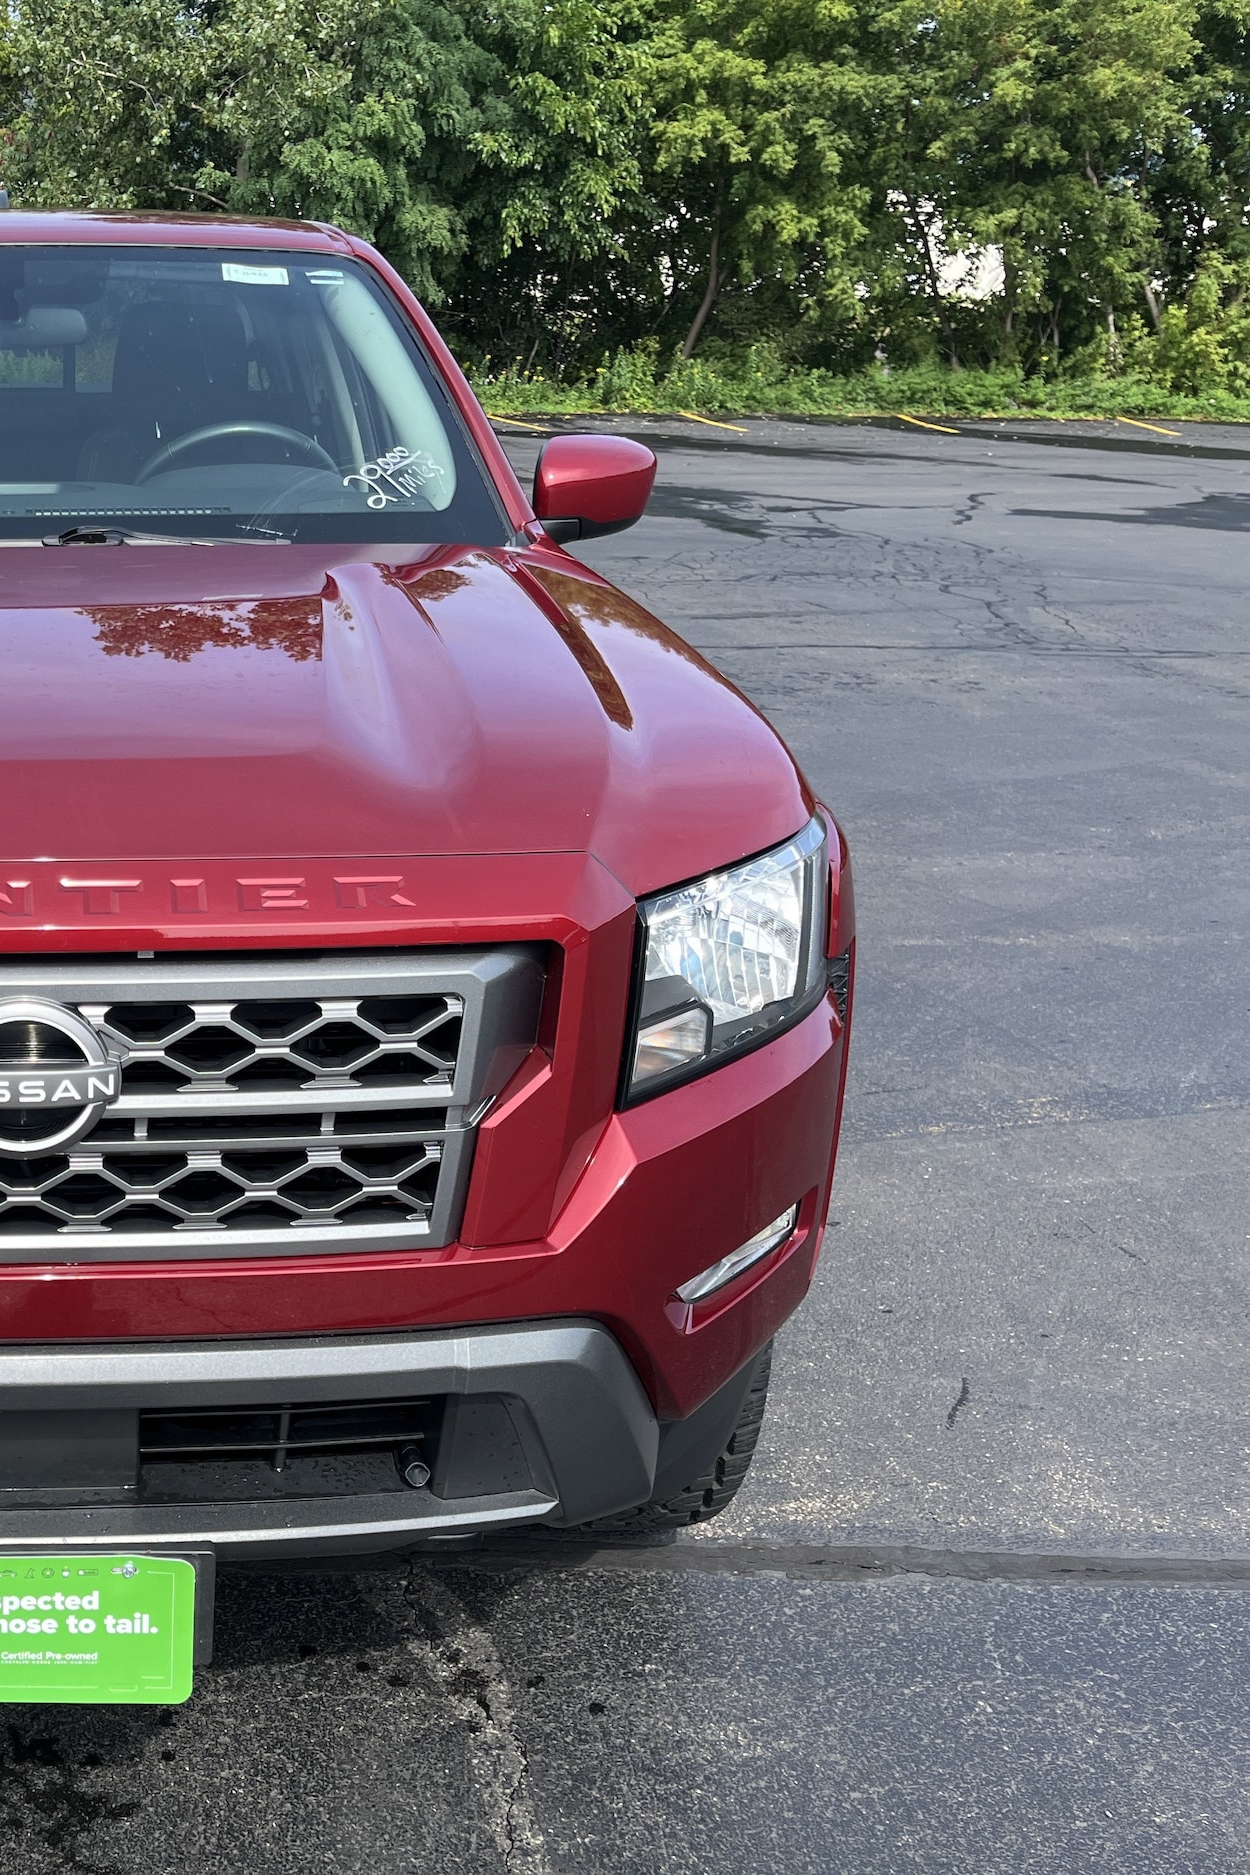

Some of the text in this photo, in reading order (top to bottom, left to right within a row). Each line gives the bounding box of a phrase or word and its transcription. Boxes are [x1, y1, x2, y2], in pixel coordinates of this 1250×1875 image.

[66, 1614, 96, 1634] to
[104, 1612, 158, 1634] tail.
[0, 1651, 43, 1660] Certified
